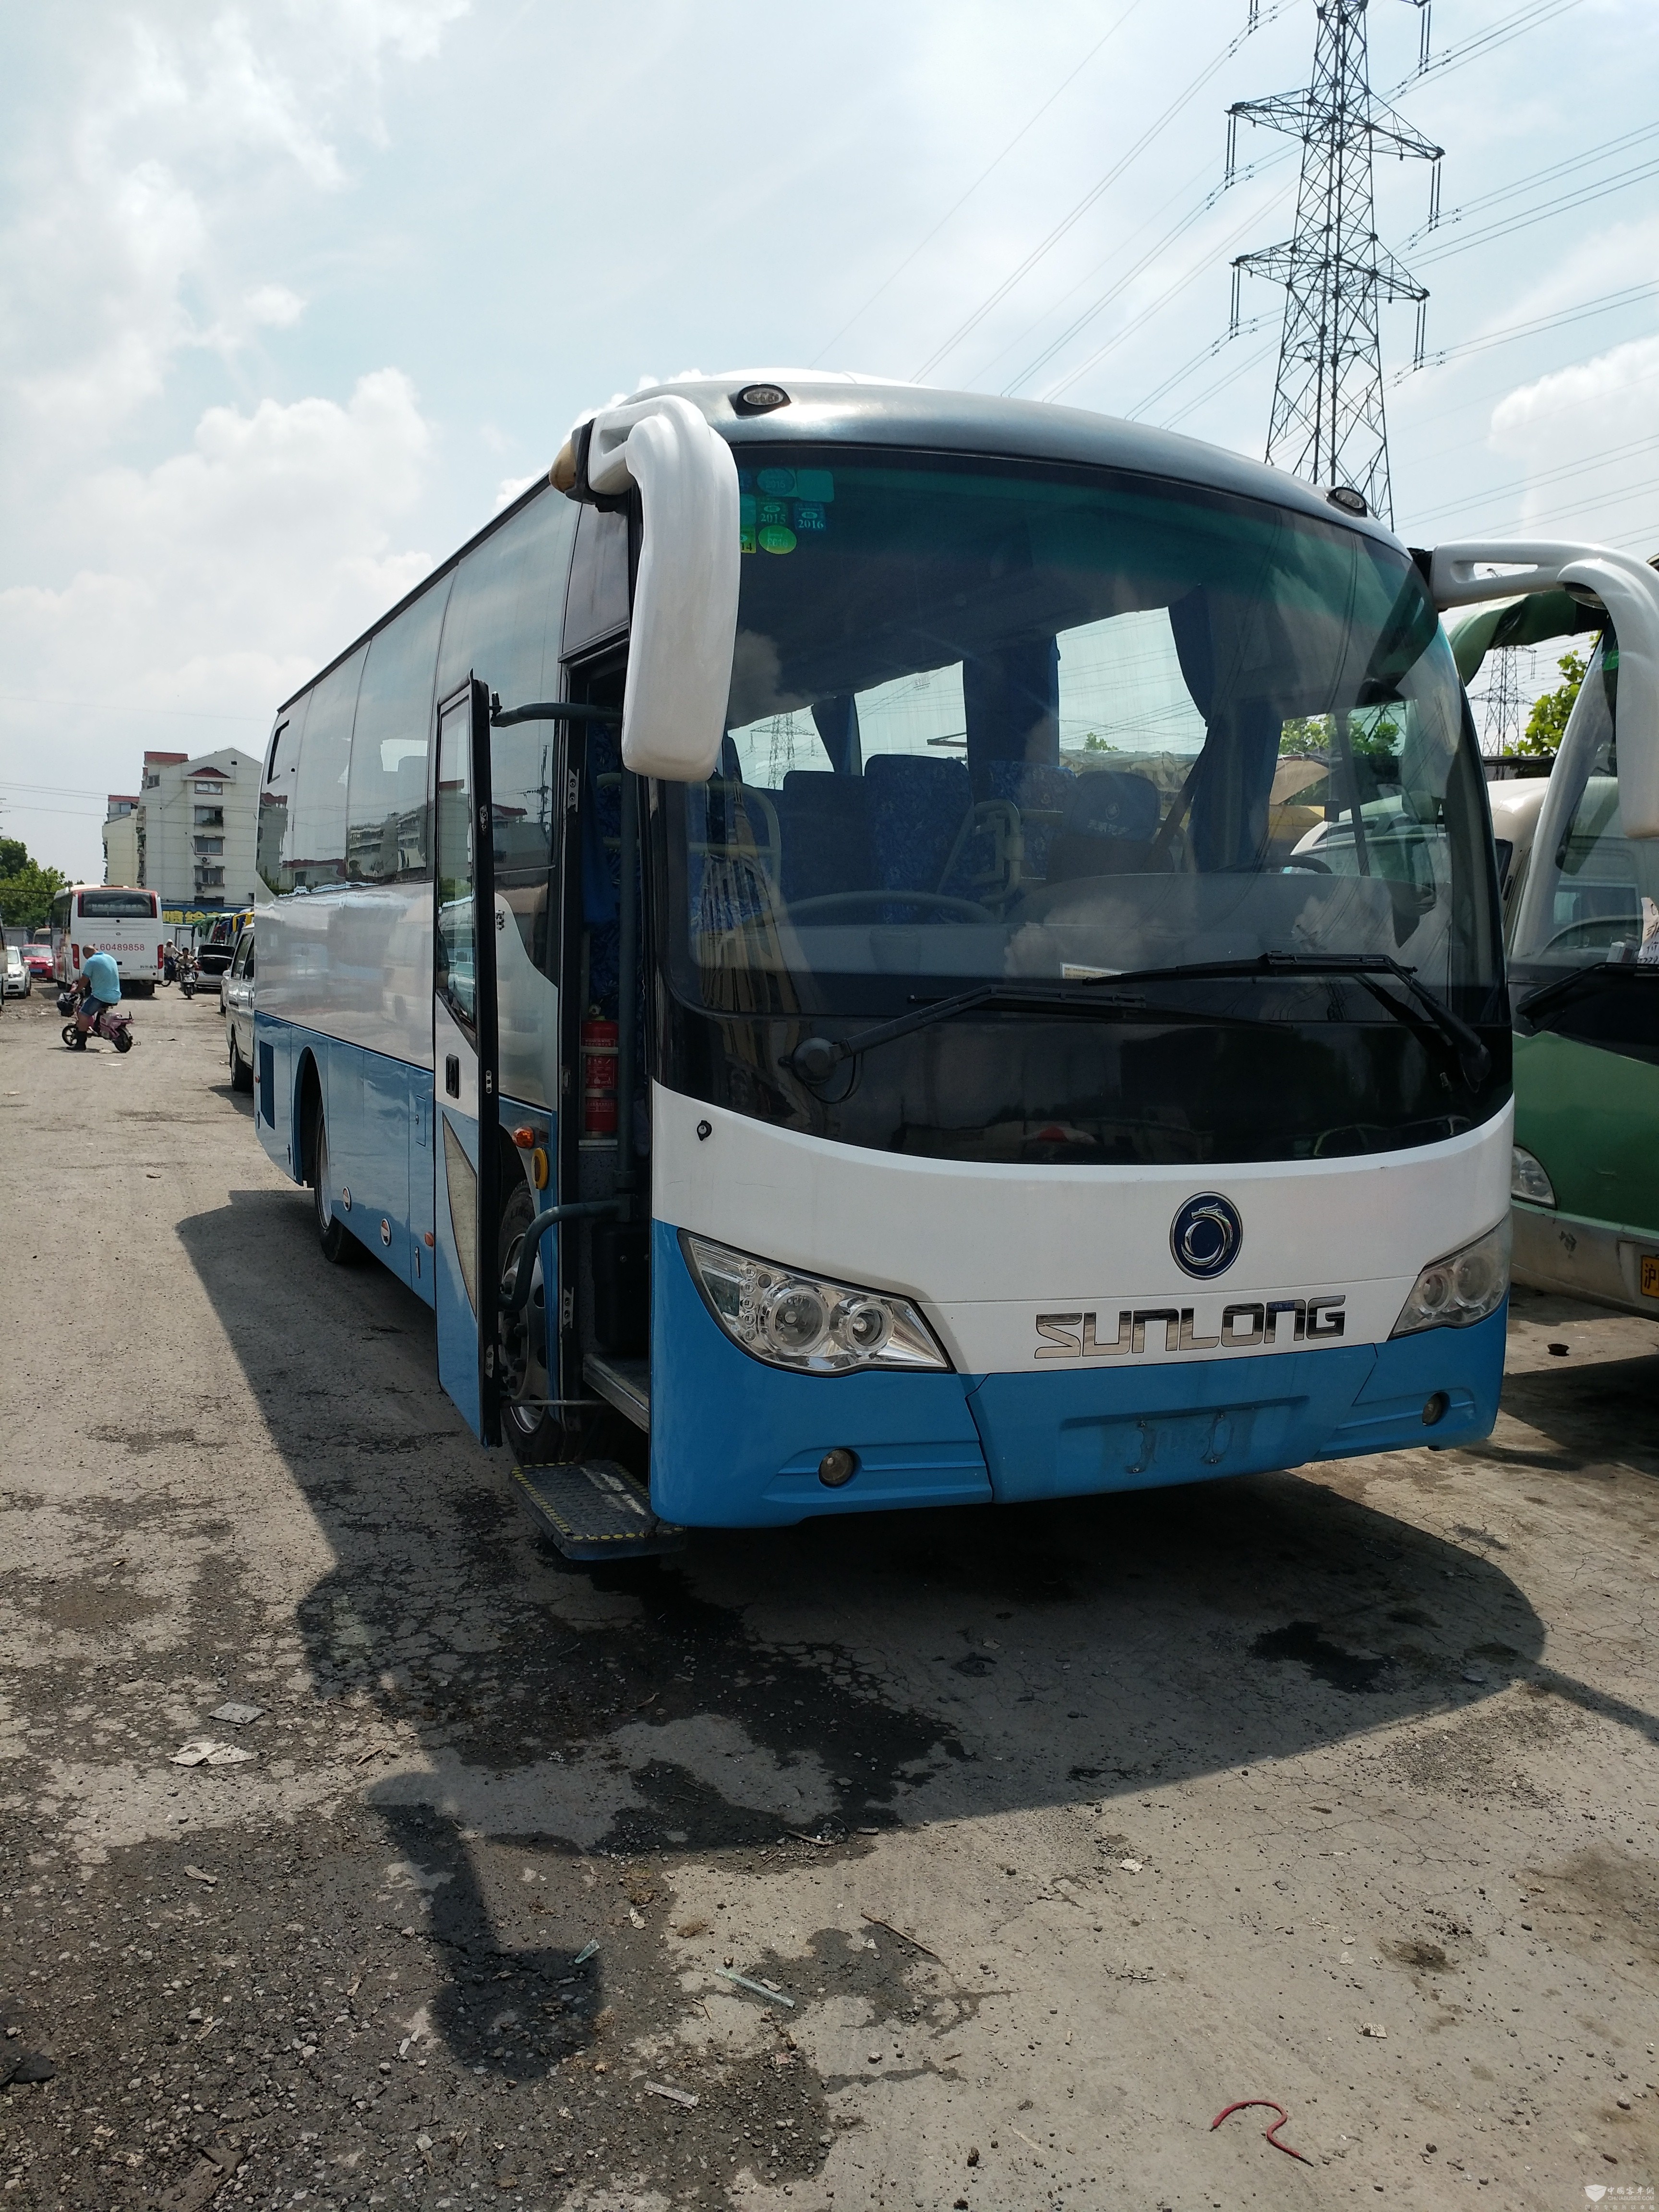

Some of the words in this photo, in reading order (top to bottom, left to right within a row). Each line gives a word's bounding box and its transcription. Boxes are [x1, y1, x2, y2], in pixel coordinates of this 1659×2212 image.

[760, 513, 786, 524] 2015
[798, 519, 824, 529] 2016
[741, 542, 753, 551] 14
[163, 910, 220, 925] 喷绘
[1644, 1262, 1659, 1290] 沪
[1034, 1295, 1346, 1359] SUNLONG
